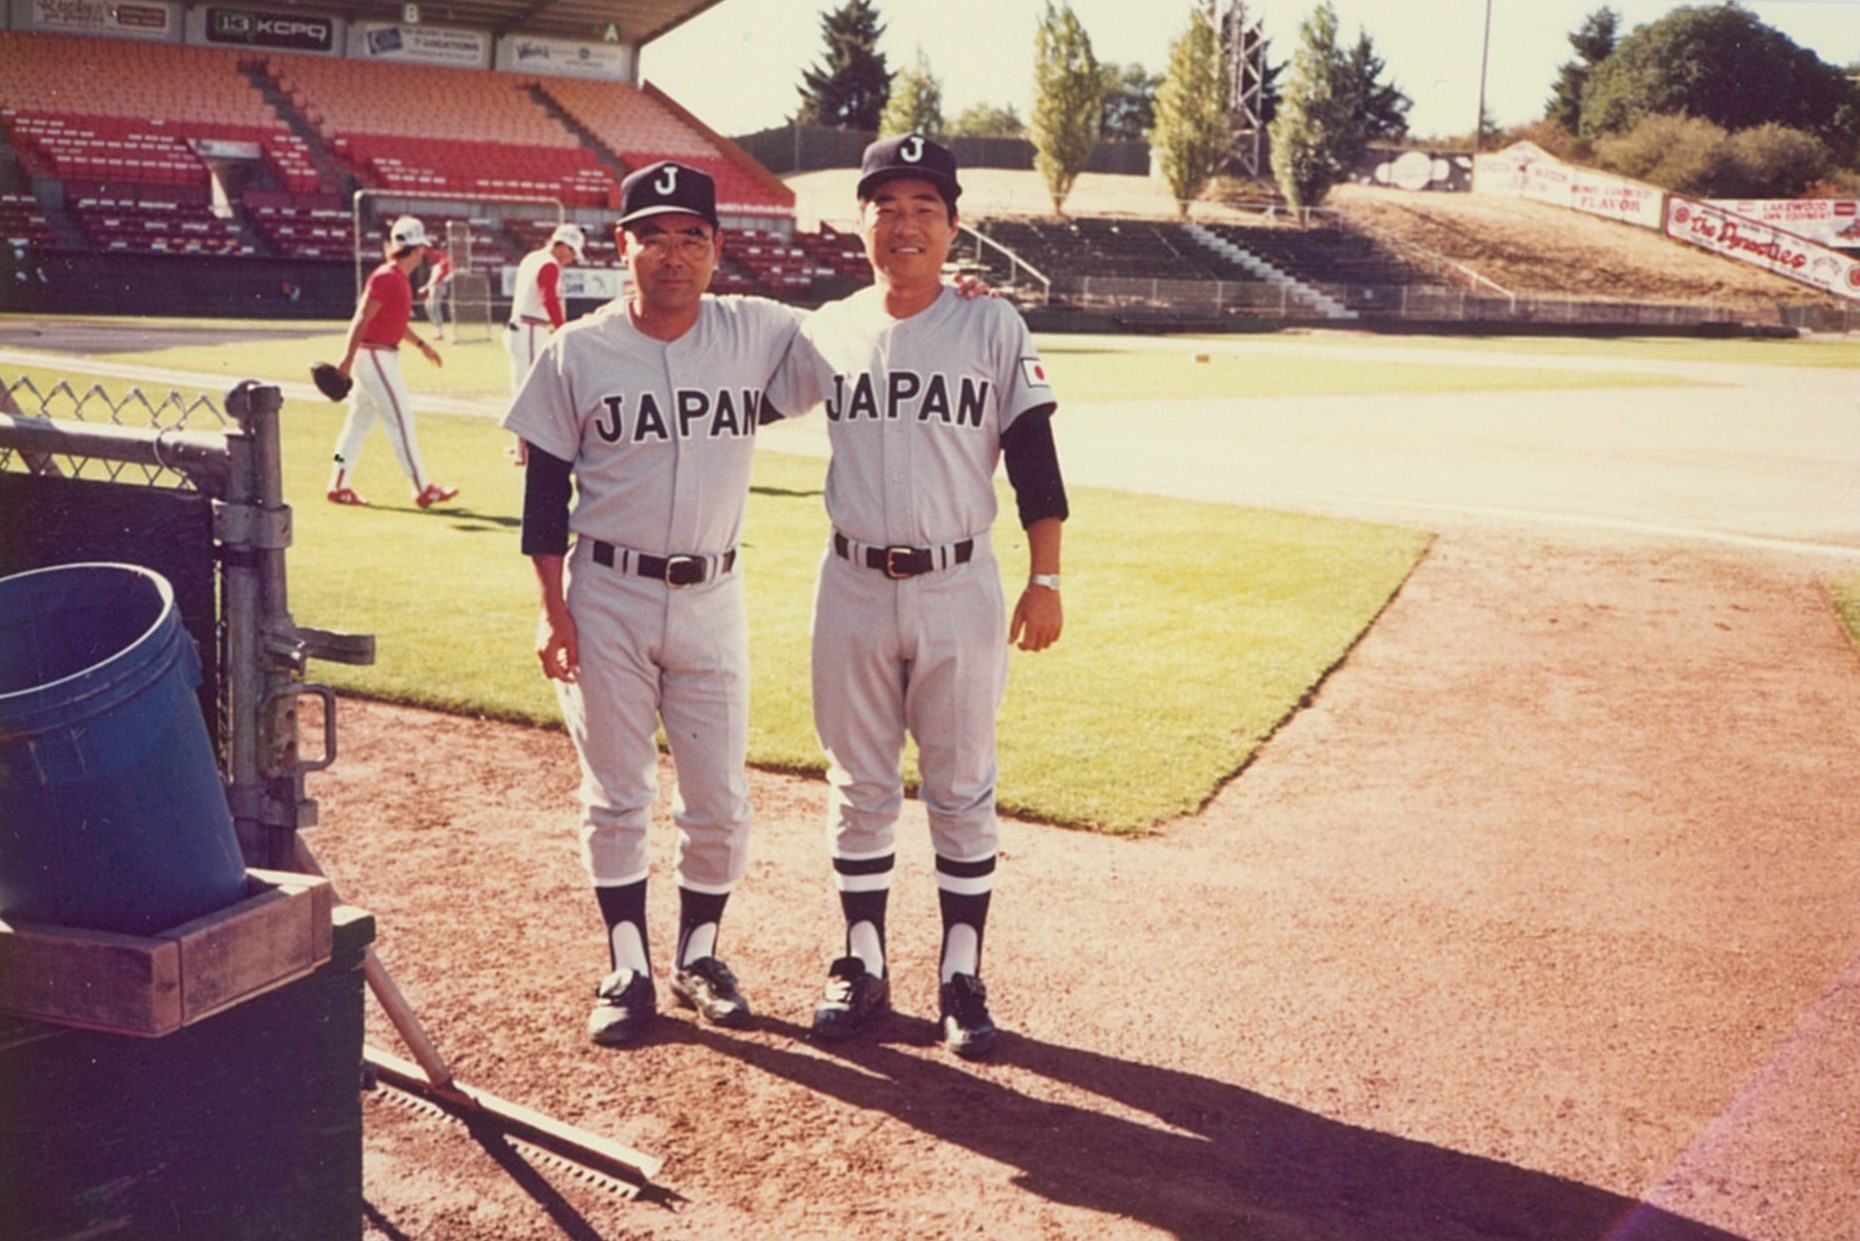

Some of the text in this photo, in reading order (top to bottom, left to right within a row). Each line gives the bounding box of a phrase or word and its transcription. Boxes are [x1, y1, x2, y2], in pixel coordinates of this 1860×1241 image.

[404, 3, 419, 23] B
[222, 16, 328, 42] 13 KCPQ
[603, 24, 619, 43] A
[900, 136, 925, 162] J
[654, 166, 679, 195] J
[1690, 216, 1717, 238] The
[1716, 221, 1808, 269] Dynasties
[824, 370, 991, 428] JAPAN
[594, 388, 762, 444] JAPAN
